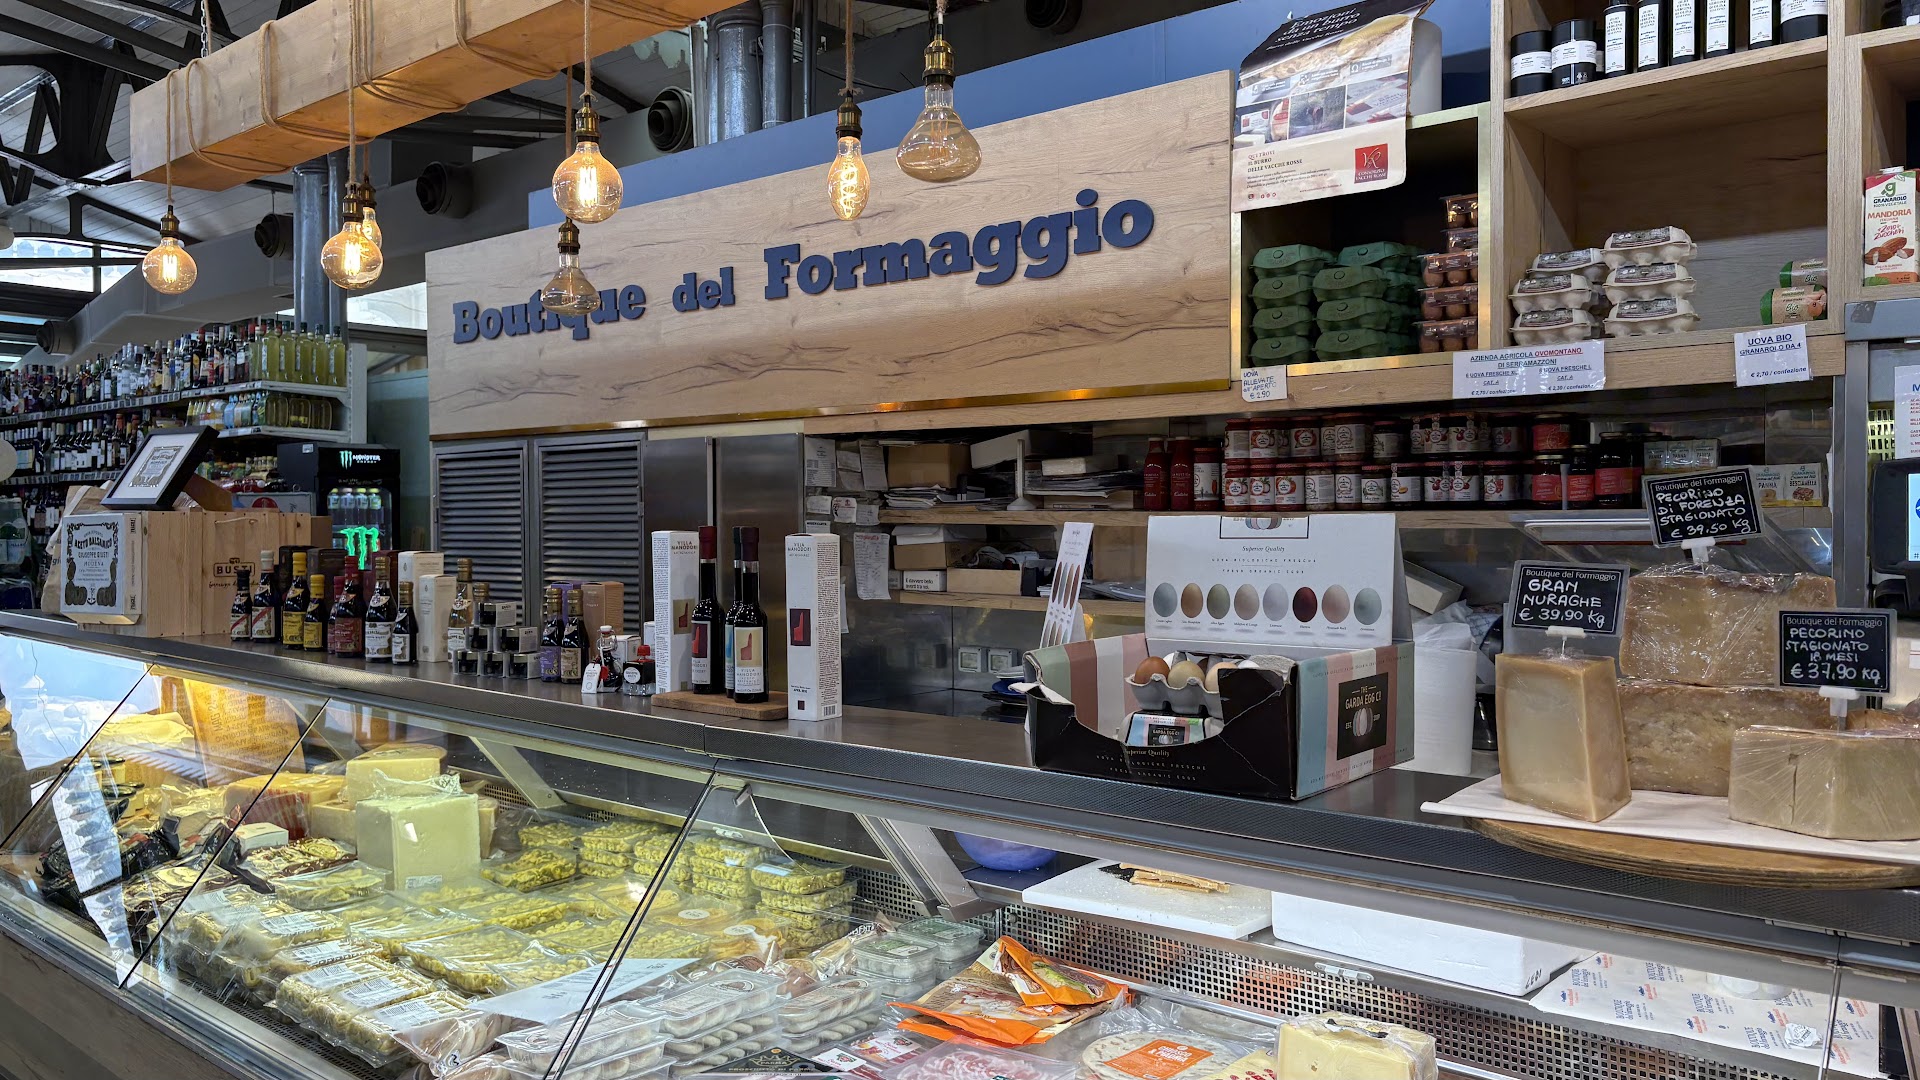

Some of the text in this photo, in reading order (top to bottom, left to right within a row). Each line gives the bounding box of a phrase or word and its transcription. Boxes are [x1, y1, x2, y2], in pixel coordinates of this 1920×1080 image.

[1286, 158, 1303, 167] ROSSE
[672, 266, 736, 313] del
[764, 188, 1155, 300] Formaggio
[1747, 333, 1792, 346] UOVA BIO
[1470, 347, 1582, 362] AZIENDA AGRICOLA OVOMONTANO
[1740, 345, 1784, 354] GRANAROLO
[1773, 367, 1807, 375] confezione
[1655, 475, 1743, 491] Boutique del Formaggio
[1679, 494, 1746, 512] FORENZA
[1660, 507, 1746, 526] STAGIONATO
[1671, 528, 1683, 538] €
[1526, 569, 1560, 579] Boutique
[1575, 571, 1616, 582] Formaggio
[1528, 579, 1578, 593] GRAN
[1522, 593, 1601, 608] NURAGHE
[1519, 608, 1605, 628] € 39,90 Kg
[1786, 617, 1882, 628] Boutique del Formaggio
[1790, 628, 1865, 638] PECORINO
[1785, 641, 1869, 652] STAGIONATO
[1810, 652, 1858, 662] 18 MESI
[1791, 663, 1803, 678] €
[1808, 663, 1857, 680] 37,90
[1345, 695, 1375, 709] GARDA EGG
[1148, 749, 1170, 757] Quality
[1170, 763, 1206, 771] FRESCHE
